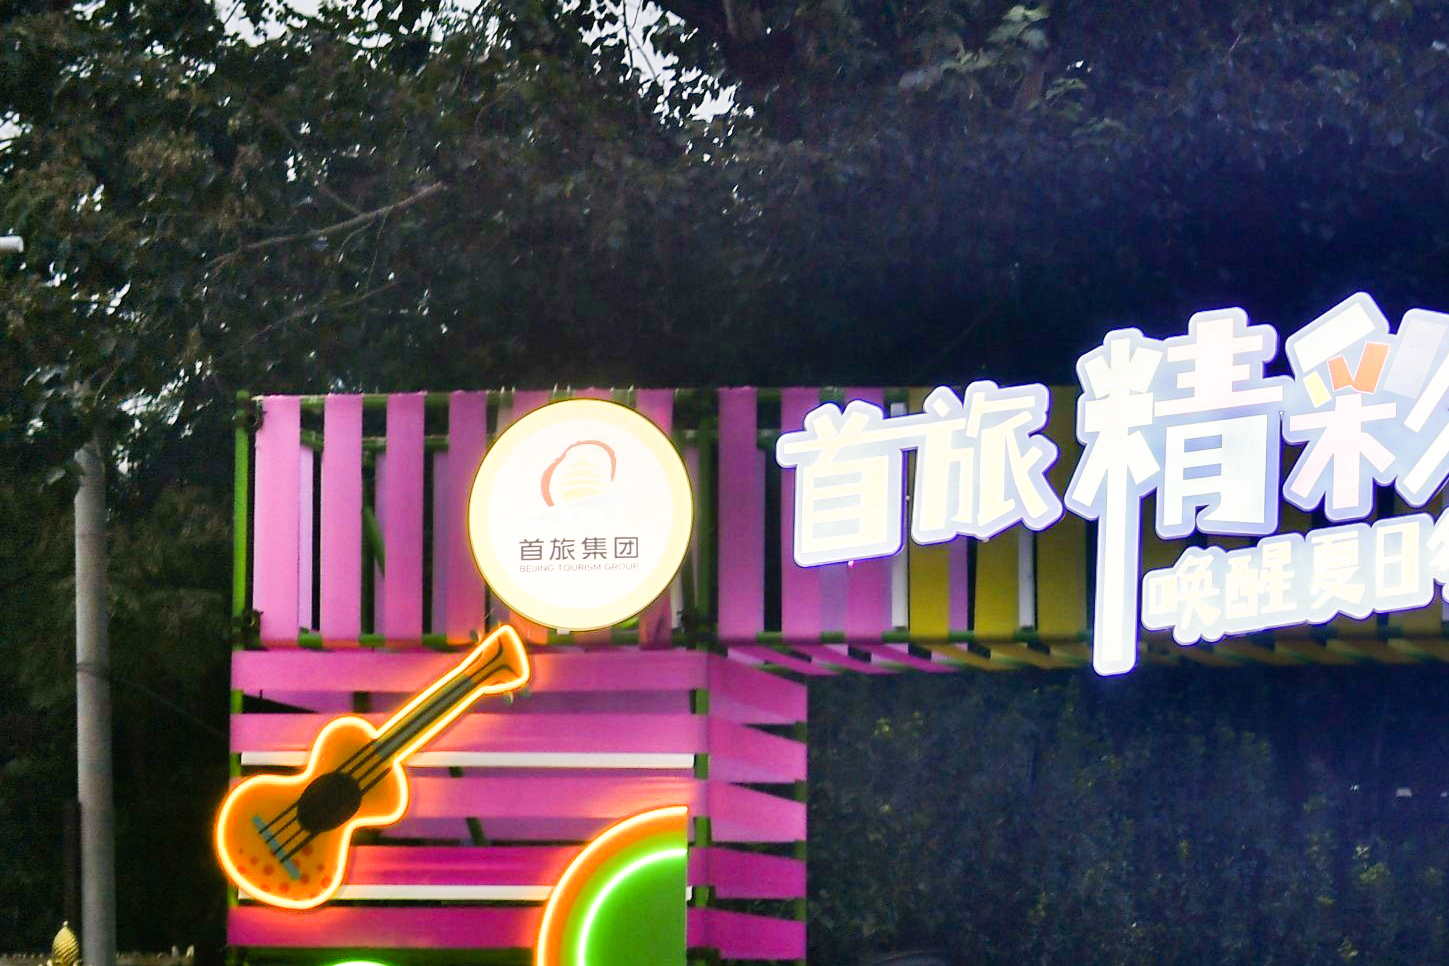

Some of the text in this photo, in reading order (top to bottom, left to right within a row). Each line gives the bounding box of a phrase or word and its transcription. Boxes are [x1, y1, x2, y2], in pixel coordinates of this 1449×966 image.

[519, 536, 639, 561] 首旅集团
[519, 562, 640, 573] BEIJING TOURISM GROUP
